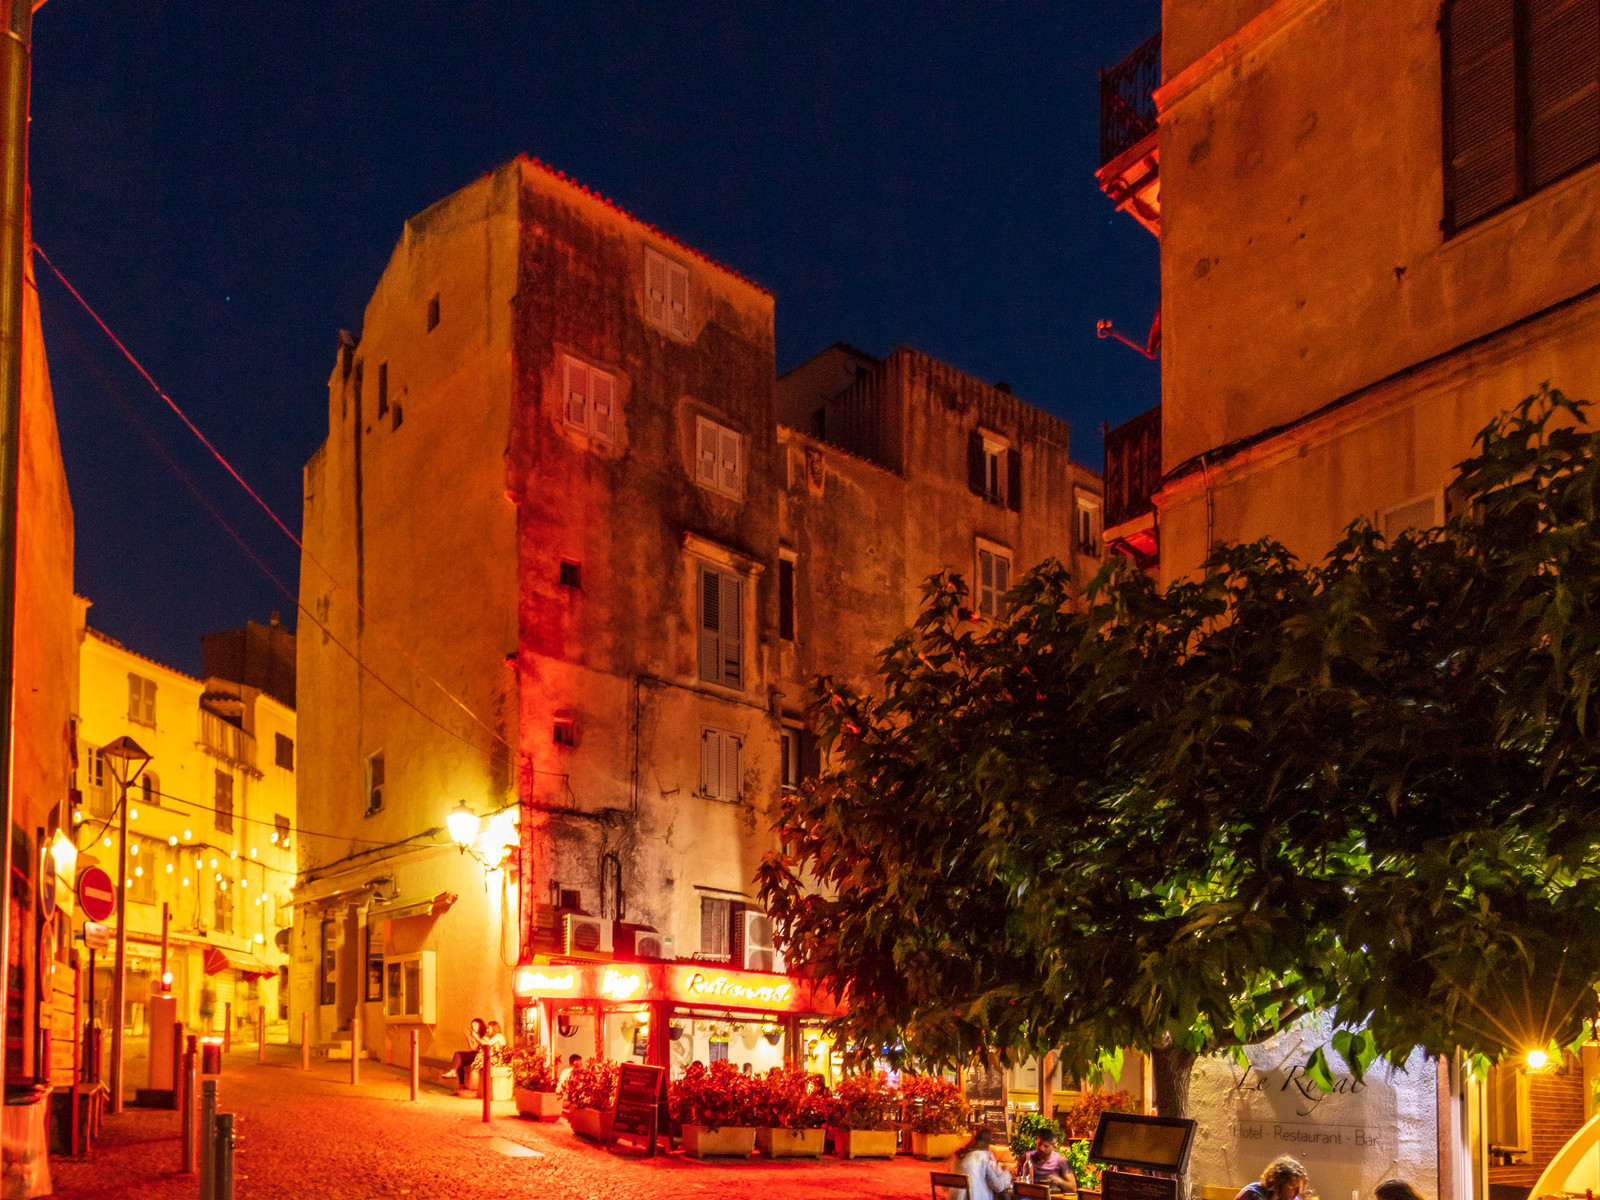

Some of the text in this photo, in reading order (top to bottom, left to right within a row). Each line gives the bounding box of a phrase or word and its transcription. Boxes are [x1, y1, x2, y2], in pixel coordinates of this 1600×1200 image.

[1232, 1064, 1272, 1092] Le
[1274, 1125, 1342, 1145] Restaurant
[1355, 1130, 1379, 1147] Bar
